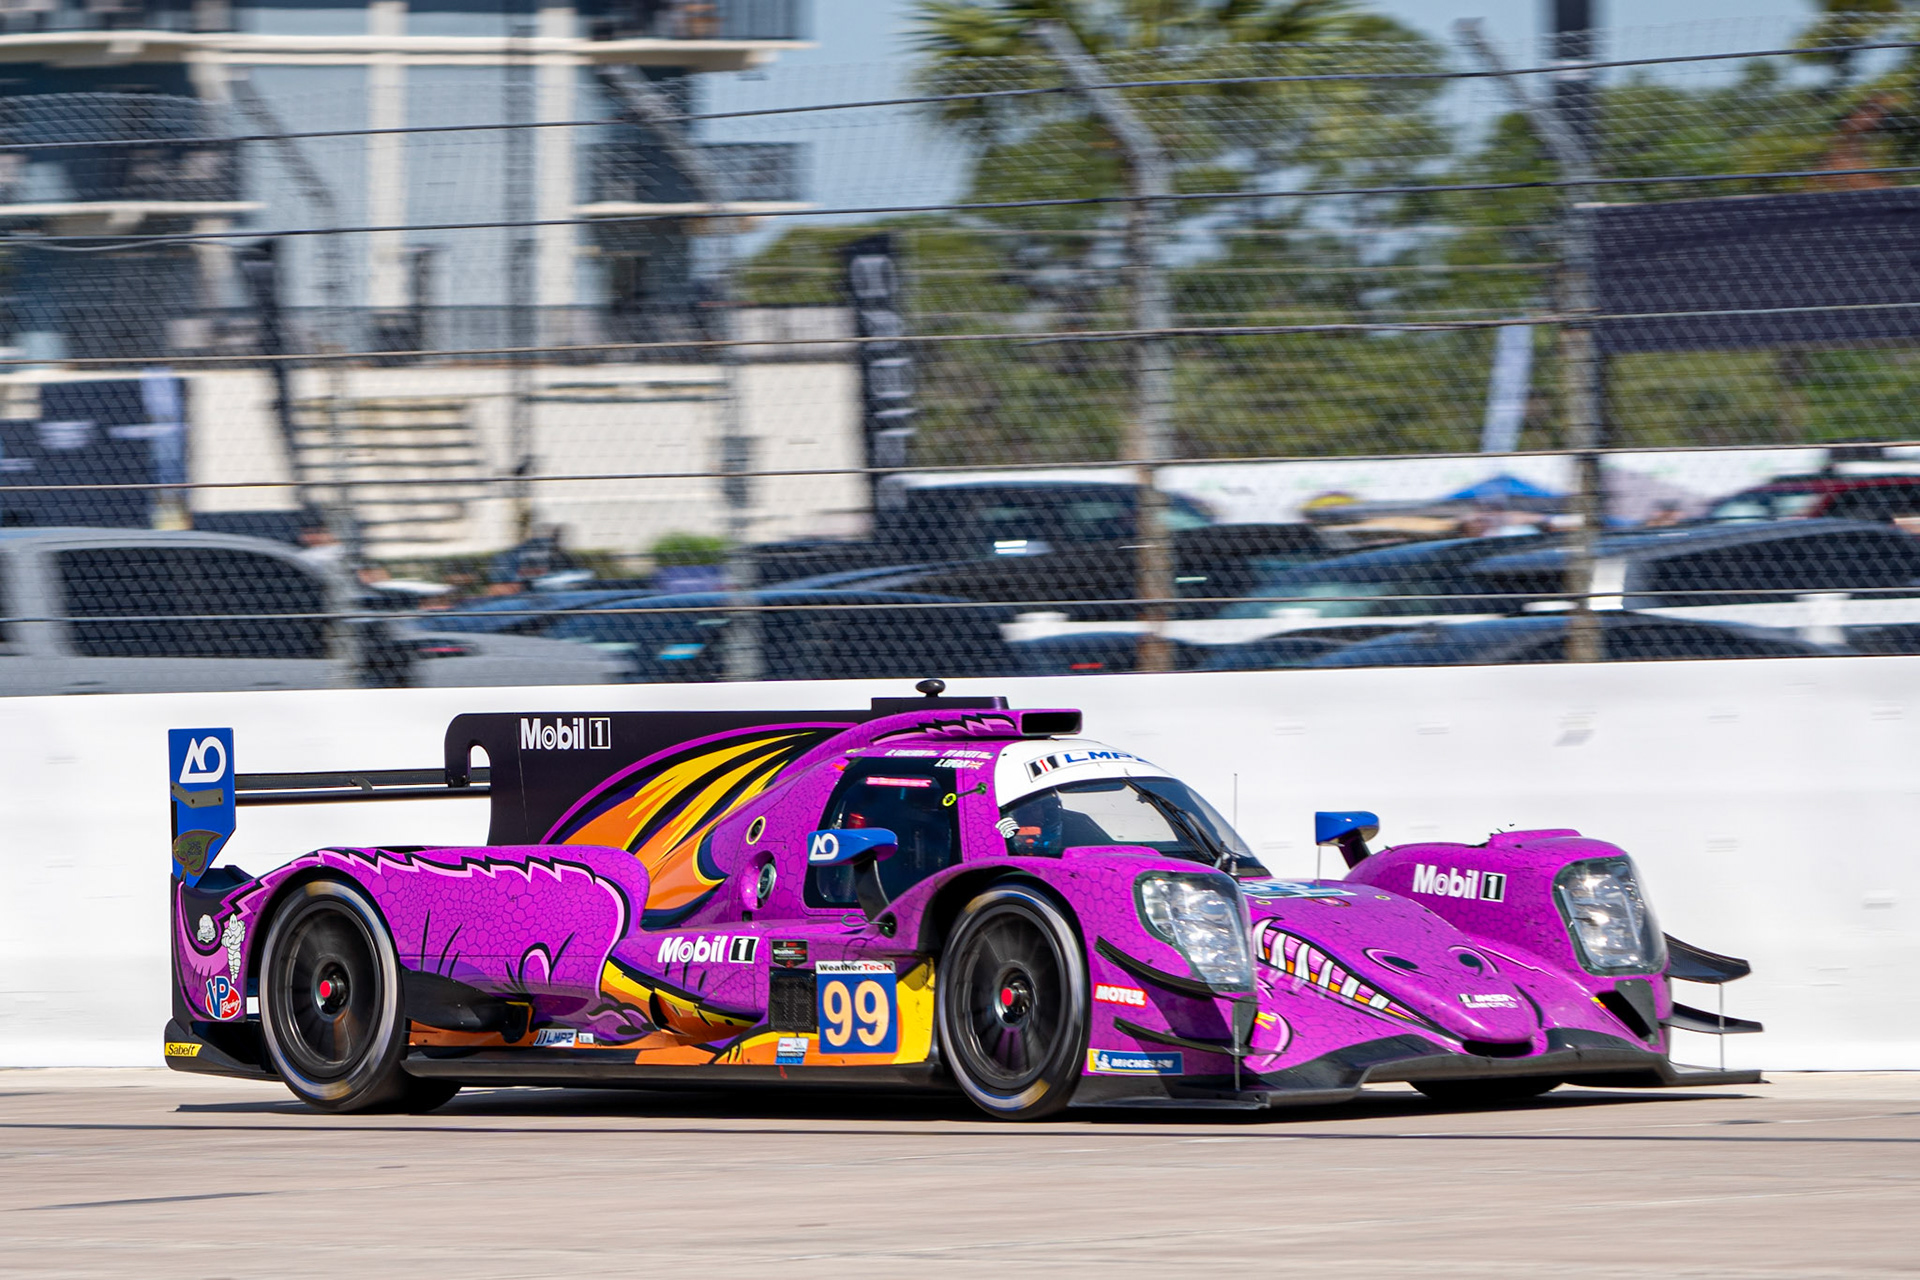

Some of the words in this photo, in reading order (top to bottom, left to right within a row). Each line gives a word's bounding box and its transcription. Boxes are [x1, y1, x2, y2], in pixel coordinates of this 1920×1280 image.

[520, 717, 585, 750] Mobil
[1412, 863, 1480, 900] Mobil
[657, 935, 728, 963] Mobil
[818, 963, 893, 972] WeatherTech
[206, 976, 230, 1019] VP
[1095, 985, 1146, 1006] MOTUL
[823, 980, 890, 1047] 99
[1110, 1058, 1174, 1069] MICHELIN
